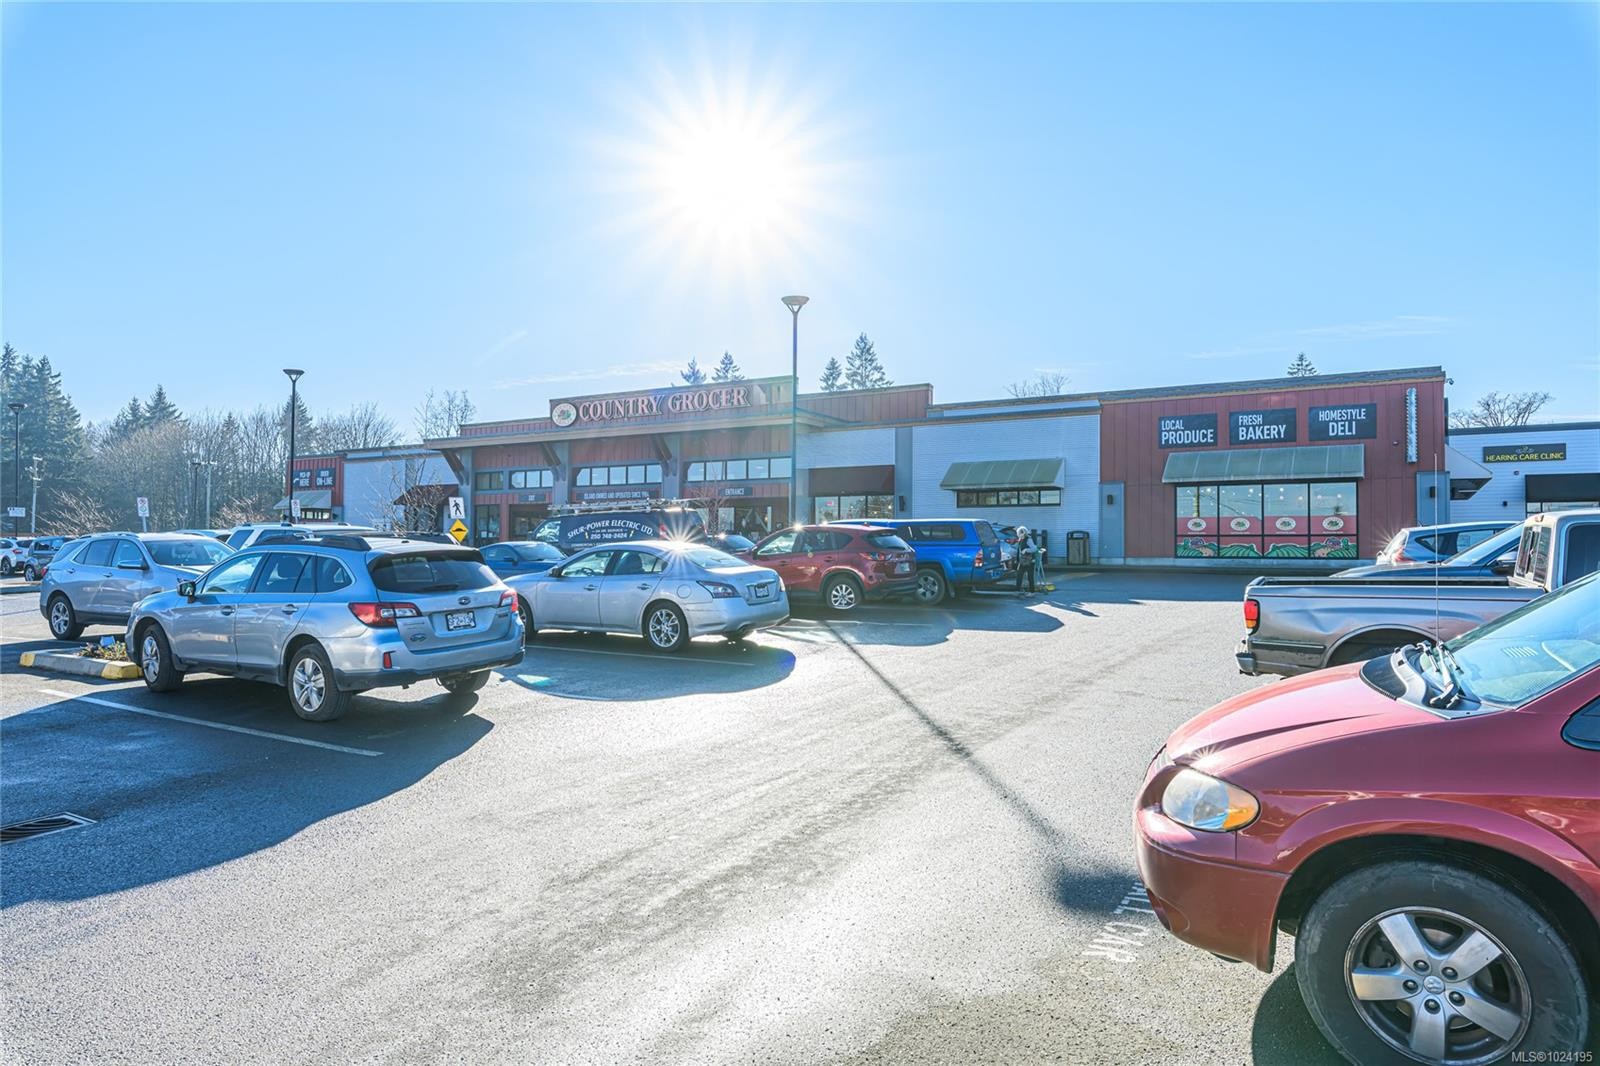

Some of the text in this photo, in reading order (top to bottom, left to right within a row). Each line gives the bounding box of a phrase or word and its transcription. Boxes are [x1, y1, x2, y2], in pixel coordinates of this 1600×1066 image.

[579, 395, 664, 422] COUNTRY
[668, 387, 750, 413] GROCER
[1238, 415, 1263, 426] FRESH
[1318, 408, 1366, 421] HOMESTYLE
[1161, 420, 1184, 431] LOCAL
[1238, 424, 1286, 441] BAKERY
[1328, 421, 1356, 436] DELI
[1161, 429, 1214, 445] PRODUCE
[1486, 454, 1517, 462] HEARING
[1540, 452, 1564, 460] CLINIC
[725, 487, 745, 496] ENTRANCE
[567, 519, 654, 539] SHUR-POWER ELECTRIC LTD.
[1081, 921, 1150, 963] CAR
